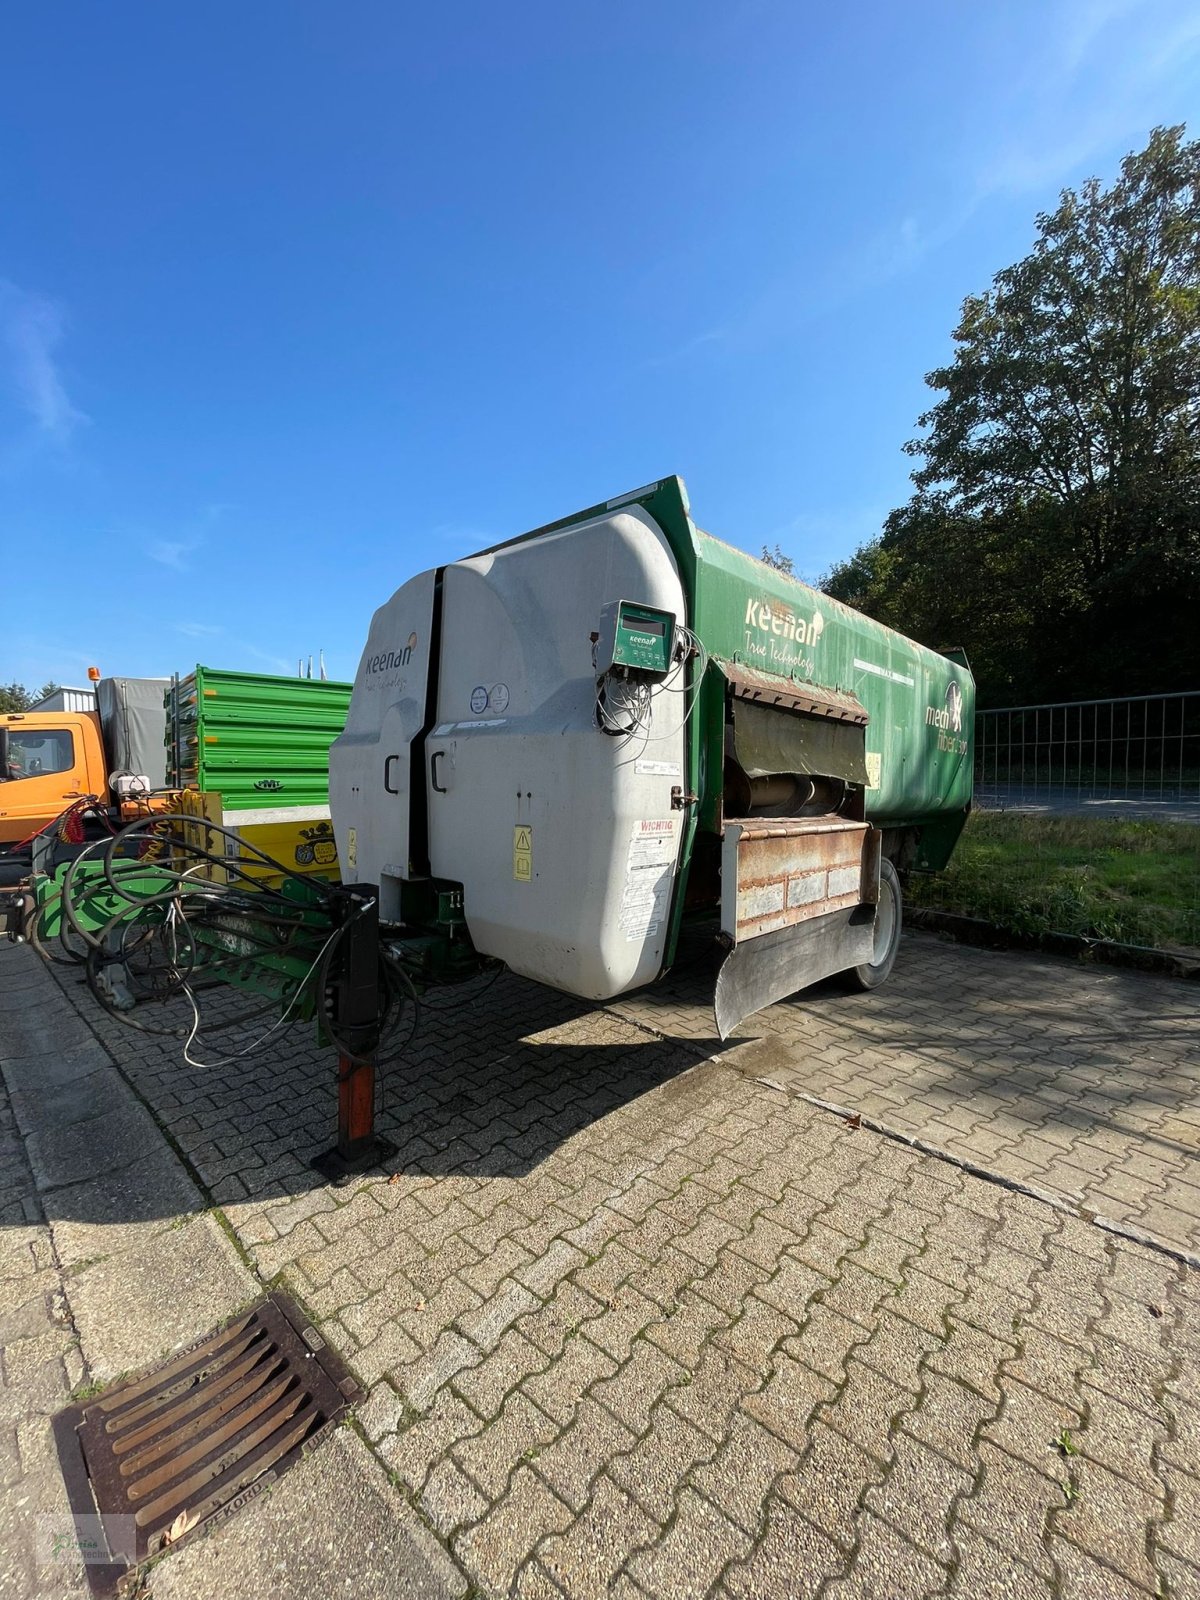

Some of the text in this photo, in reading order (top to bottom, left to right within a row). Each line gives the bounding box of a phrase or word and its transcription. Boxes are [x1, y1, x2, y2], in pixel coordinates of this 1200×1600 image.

[745, 630, 814, 677] True Technology
[925, 706, 949, 730] mech
[641, 820, 673, 832] WICHTIG
[203, 1483, 262, 1531] REKORD
